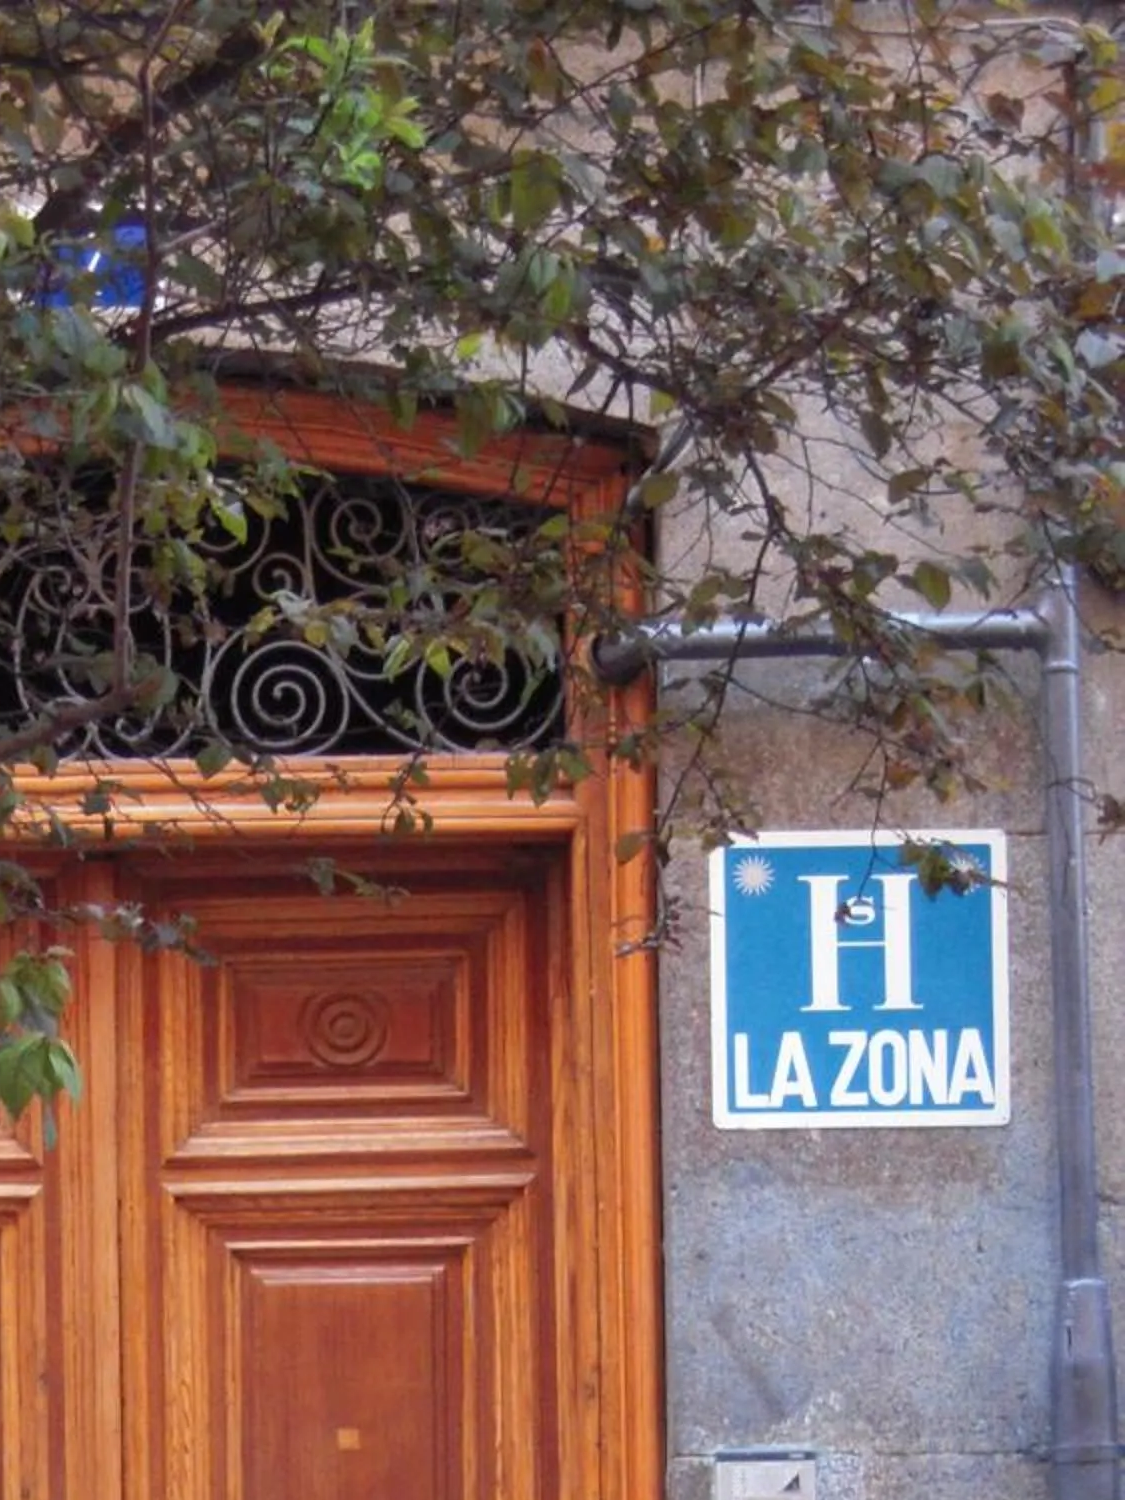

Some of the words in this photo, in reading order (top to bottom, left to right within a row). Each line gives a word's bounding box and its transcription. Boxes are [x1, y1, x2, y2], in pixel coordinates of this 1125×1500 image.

[797, 873, 924, 1012] H
[734, 1031, 818, 1109] LA
[828, 1028, 995, 1107] ZONA
